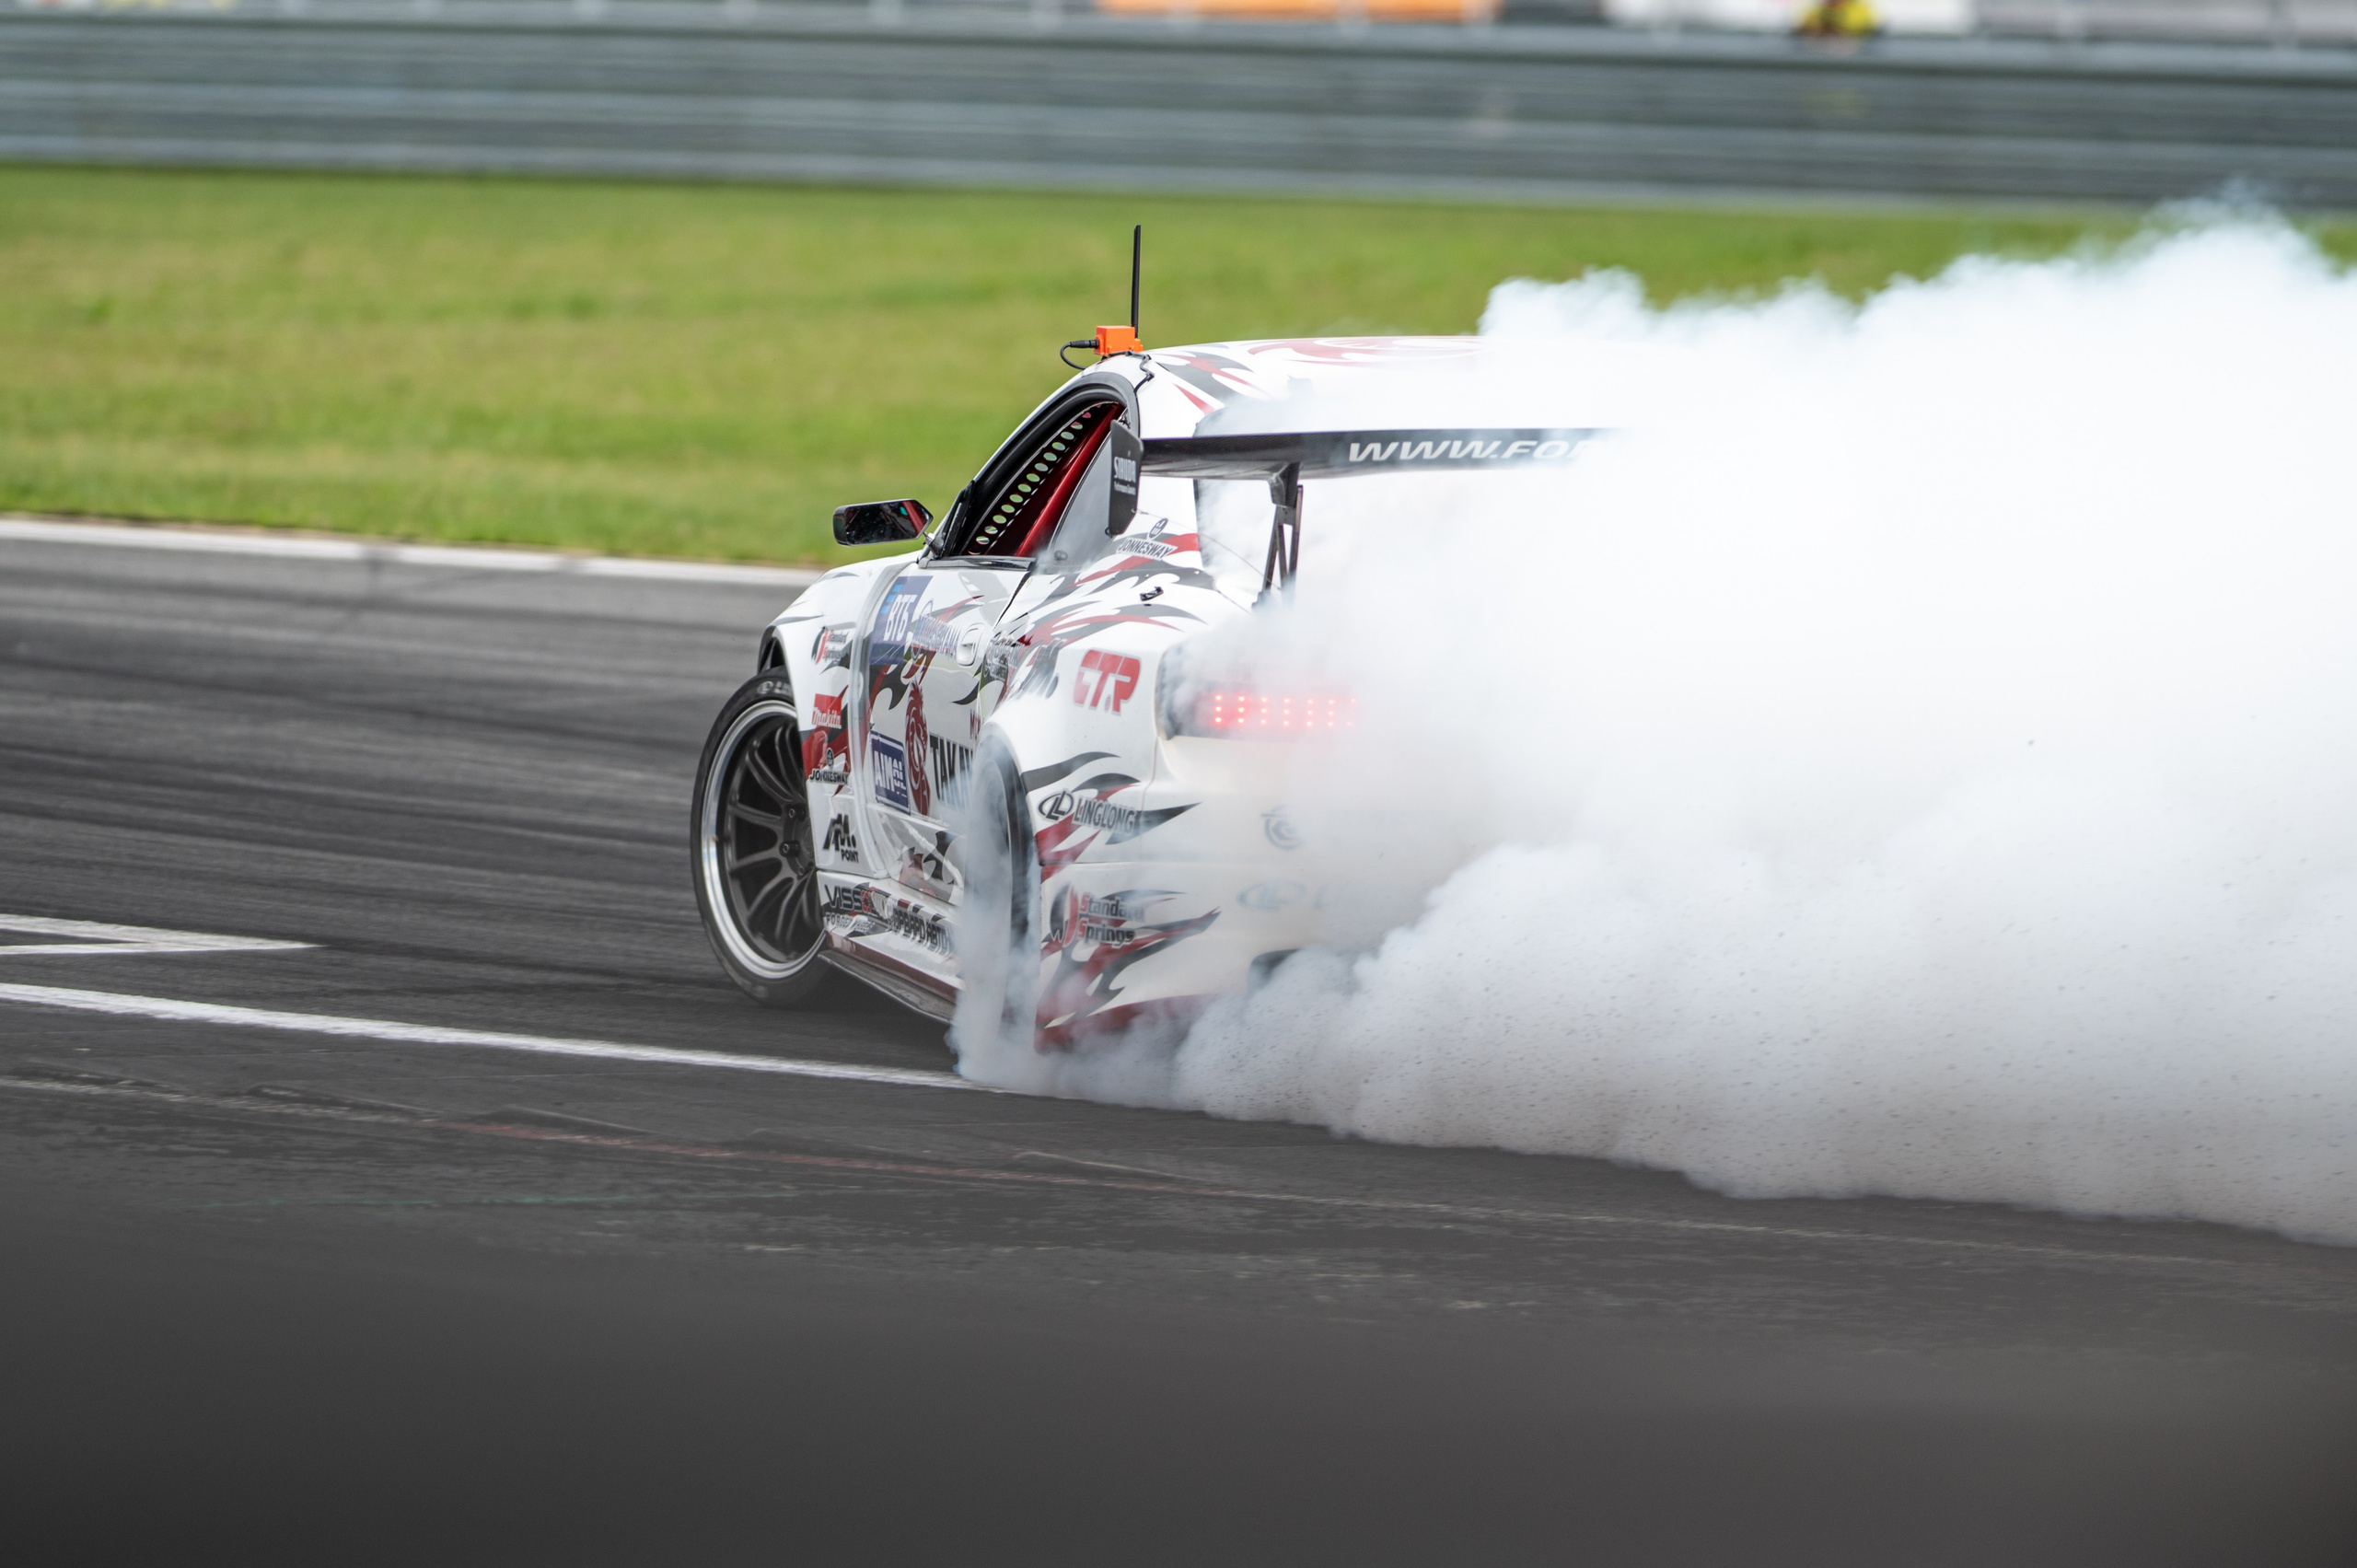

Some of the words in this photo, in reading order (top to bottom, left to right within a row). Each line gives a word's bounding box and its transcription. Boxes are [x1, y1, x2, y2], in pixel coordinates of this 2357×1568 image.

[1118, 539, 1173, 558] JONNESWAY
[1074, 798, 1134, 833] LINGLONG
[841, 849, 859, 863] POINT
[1080, 893, 1144, 922] Standard
[1078, 920, 1135, 948] Springs
